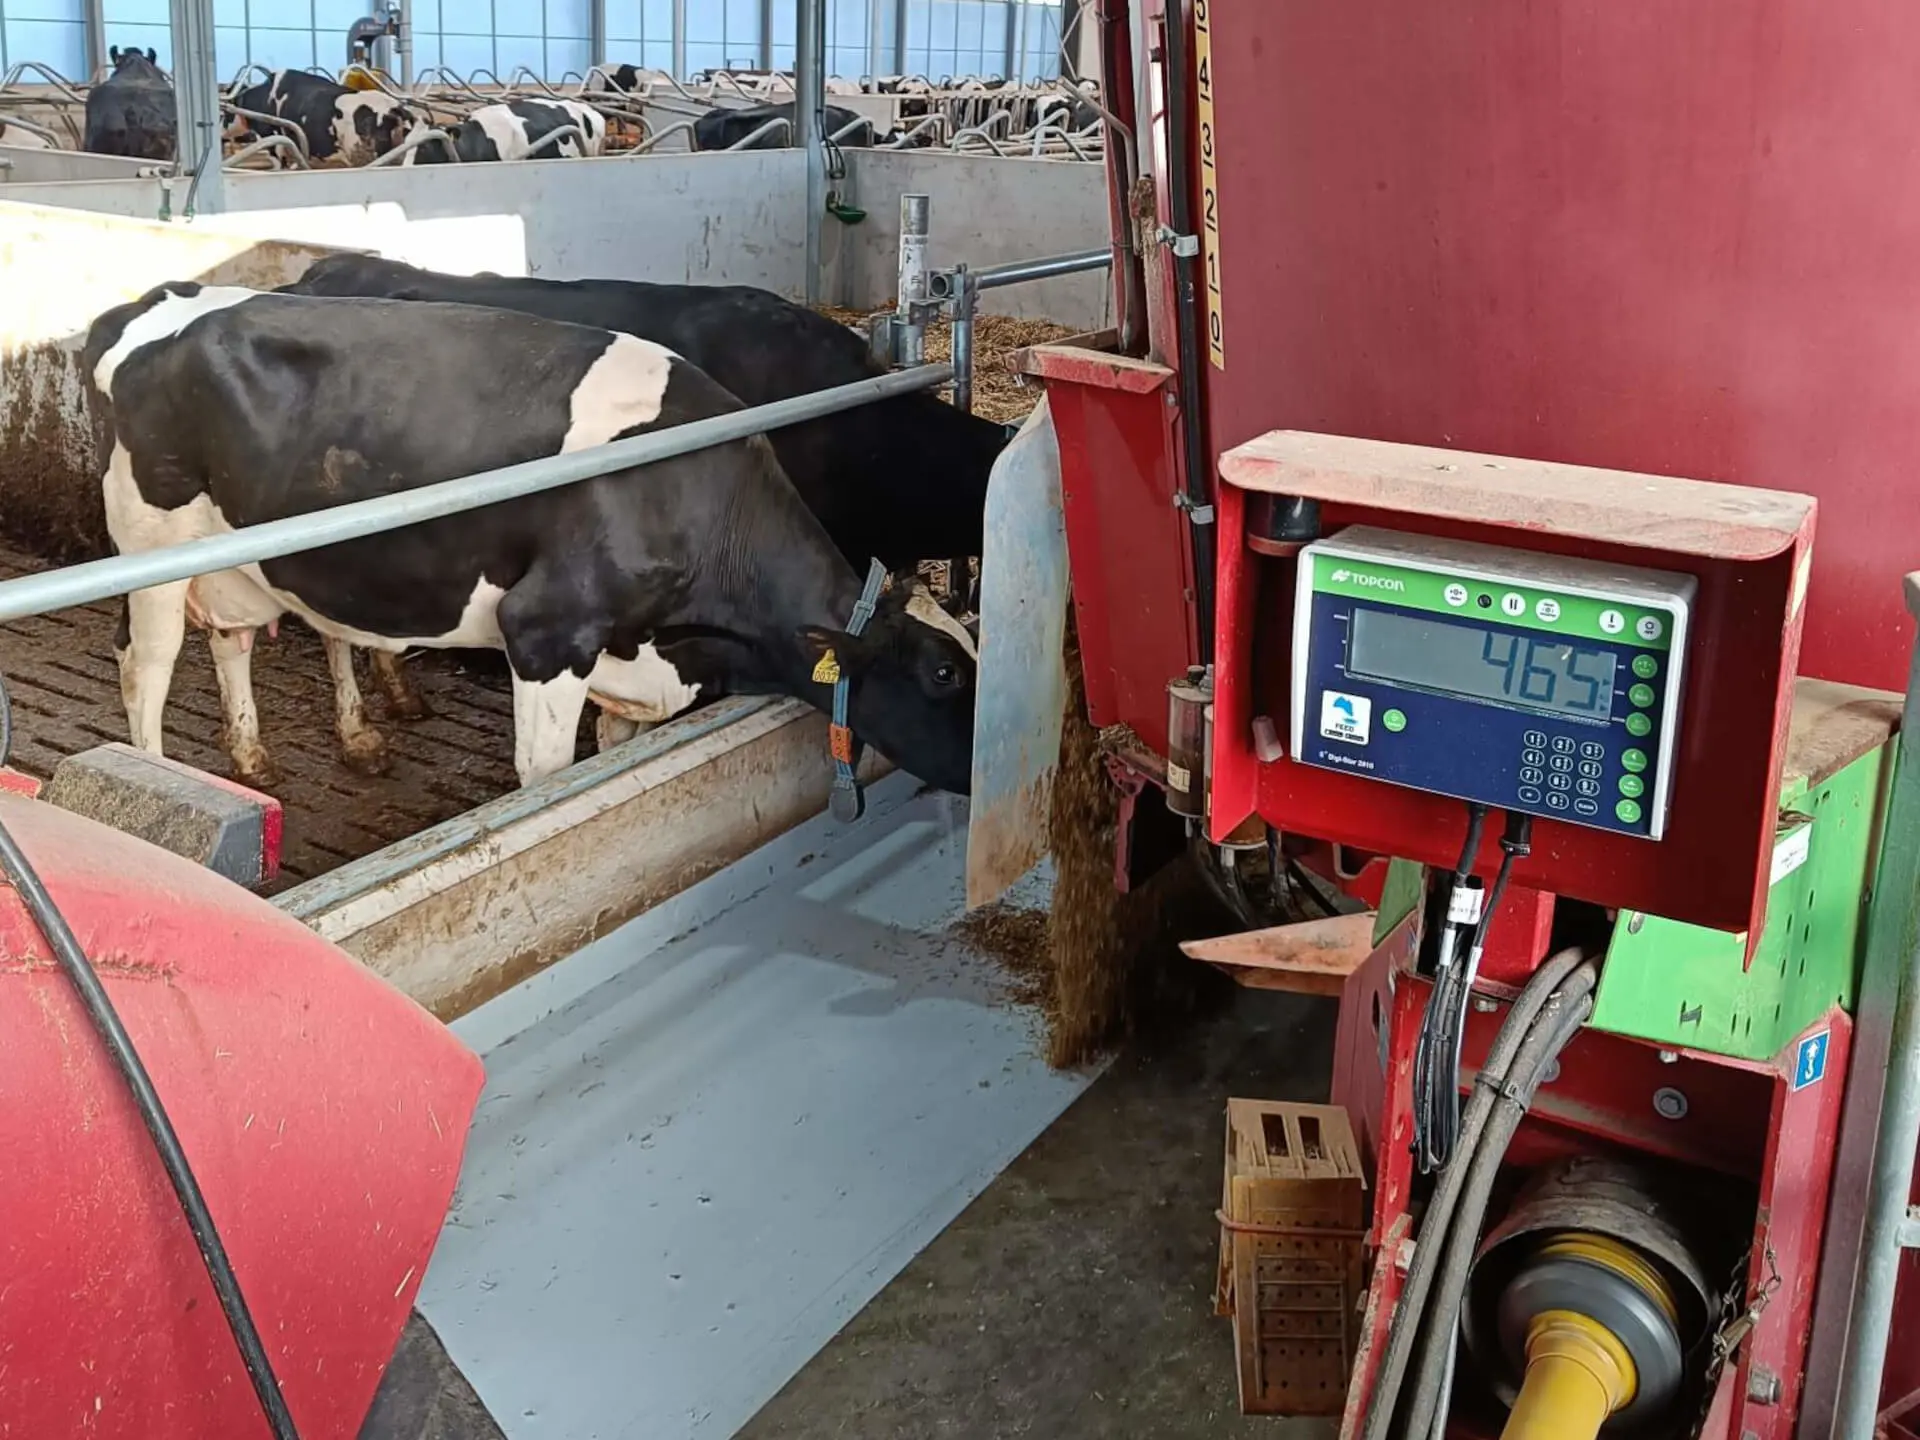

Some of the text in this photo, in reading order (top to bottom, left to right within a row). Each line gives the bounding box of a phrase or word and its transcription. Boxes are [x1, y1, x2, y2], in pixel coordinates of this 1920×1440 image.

[1199, 57, 1210, 91] 4
[1202, 123, 1213, 157] 3
[1205, 189, 1216, 220] 2
[1207, 253, 1218, 285] 1
[1211, 312, 1221, 342] 0
[1351, 572, 1406, 593] TOPCON
[1481, 630, 1600, 711] 465
